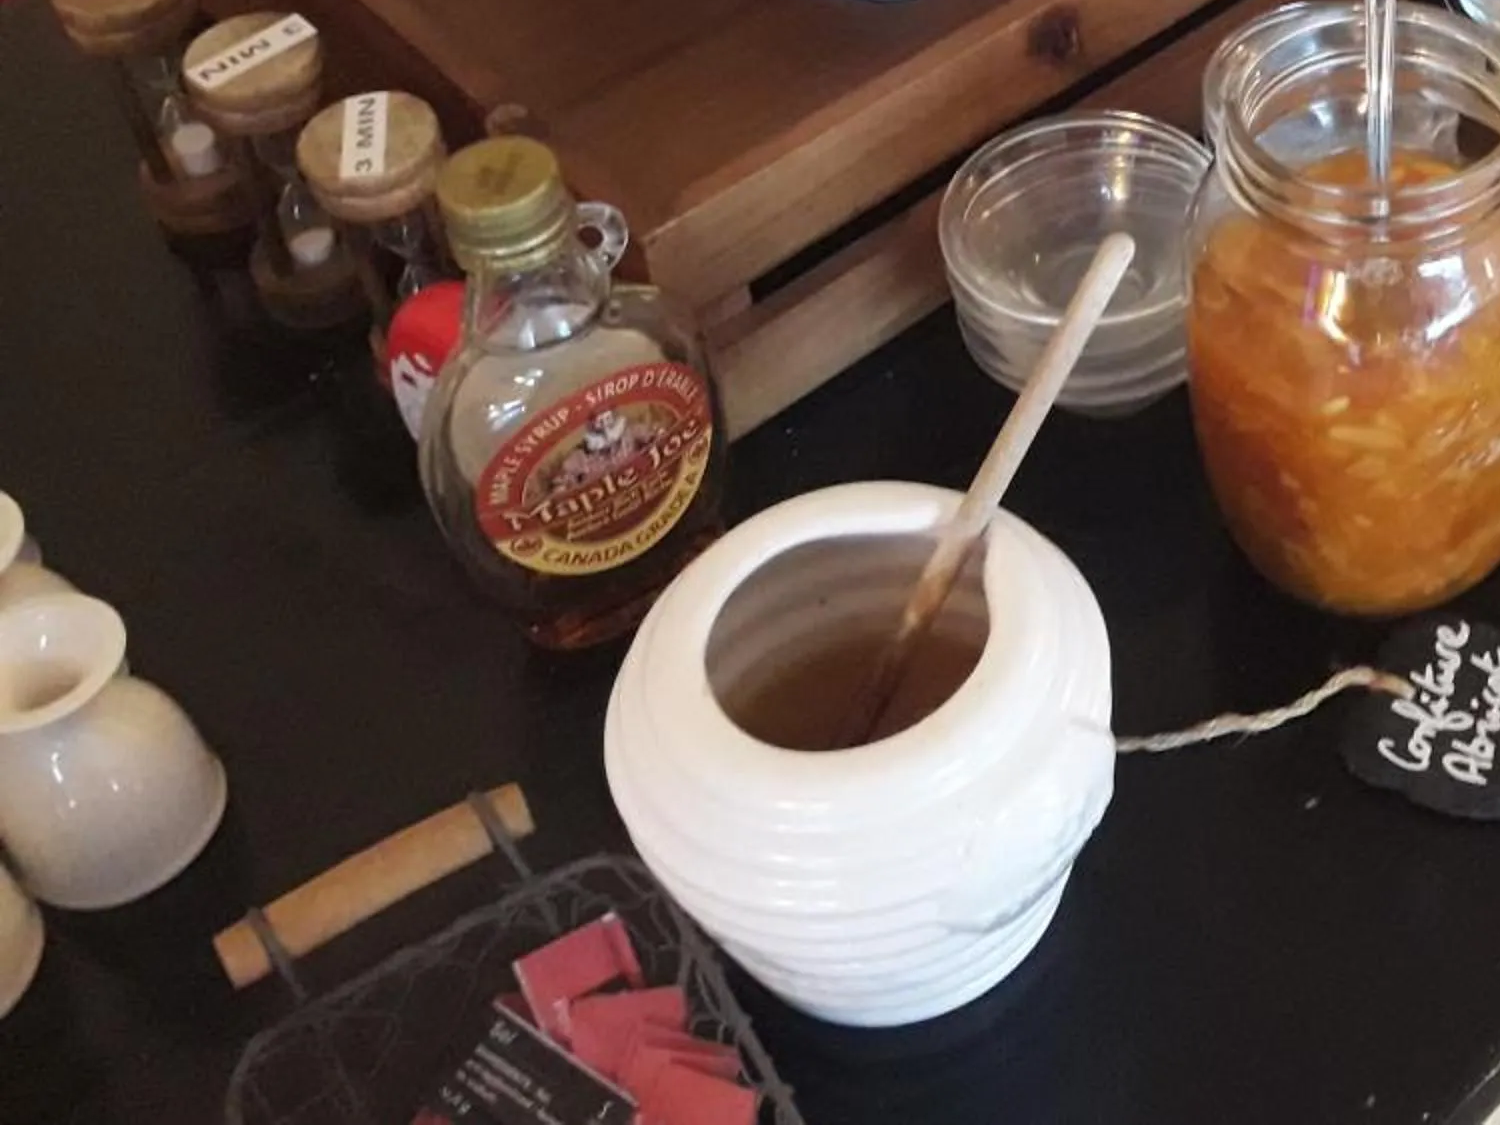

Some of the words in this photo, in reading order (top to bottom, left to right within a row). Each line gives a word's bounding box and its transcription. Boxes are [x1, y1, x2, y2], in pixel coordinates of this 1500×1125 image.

[199, 39, 271, 82] MIN
[356, 97, 376, 149] MIN
[355, 157, 372, 173] 3
[514, 408, 569, 453] SYRUP
[585, 373, 640, 404] SIROP
[503, 467, 638, 531] Maple
[650, 419, 697, 469] Joe
[542, 541, 634, 565] CANADA
[1377, 620, 1475, 772] Confiture
